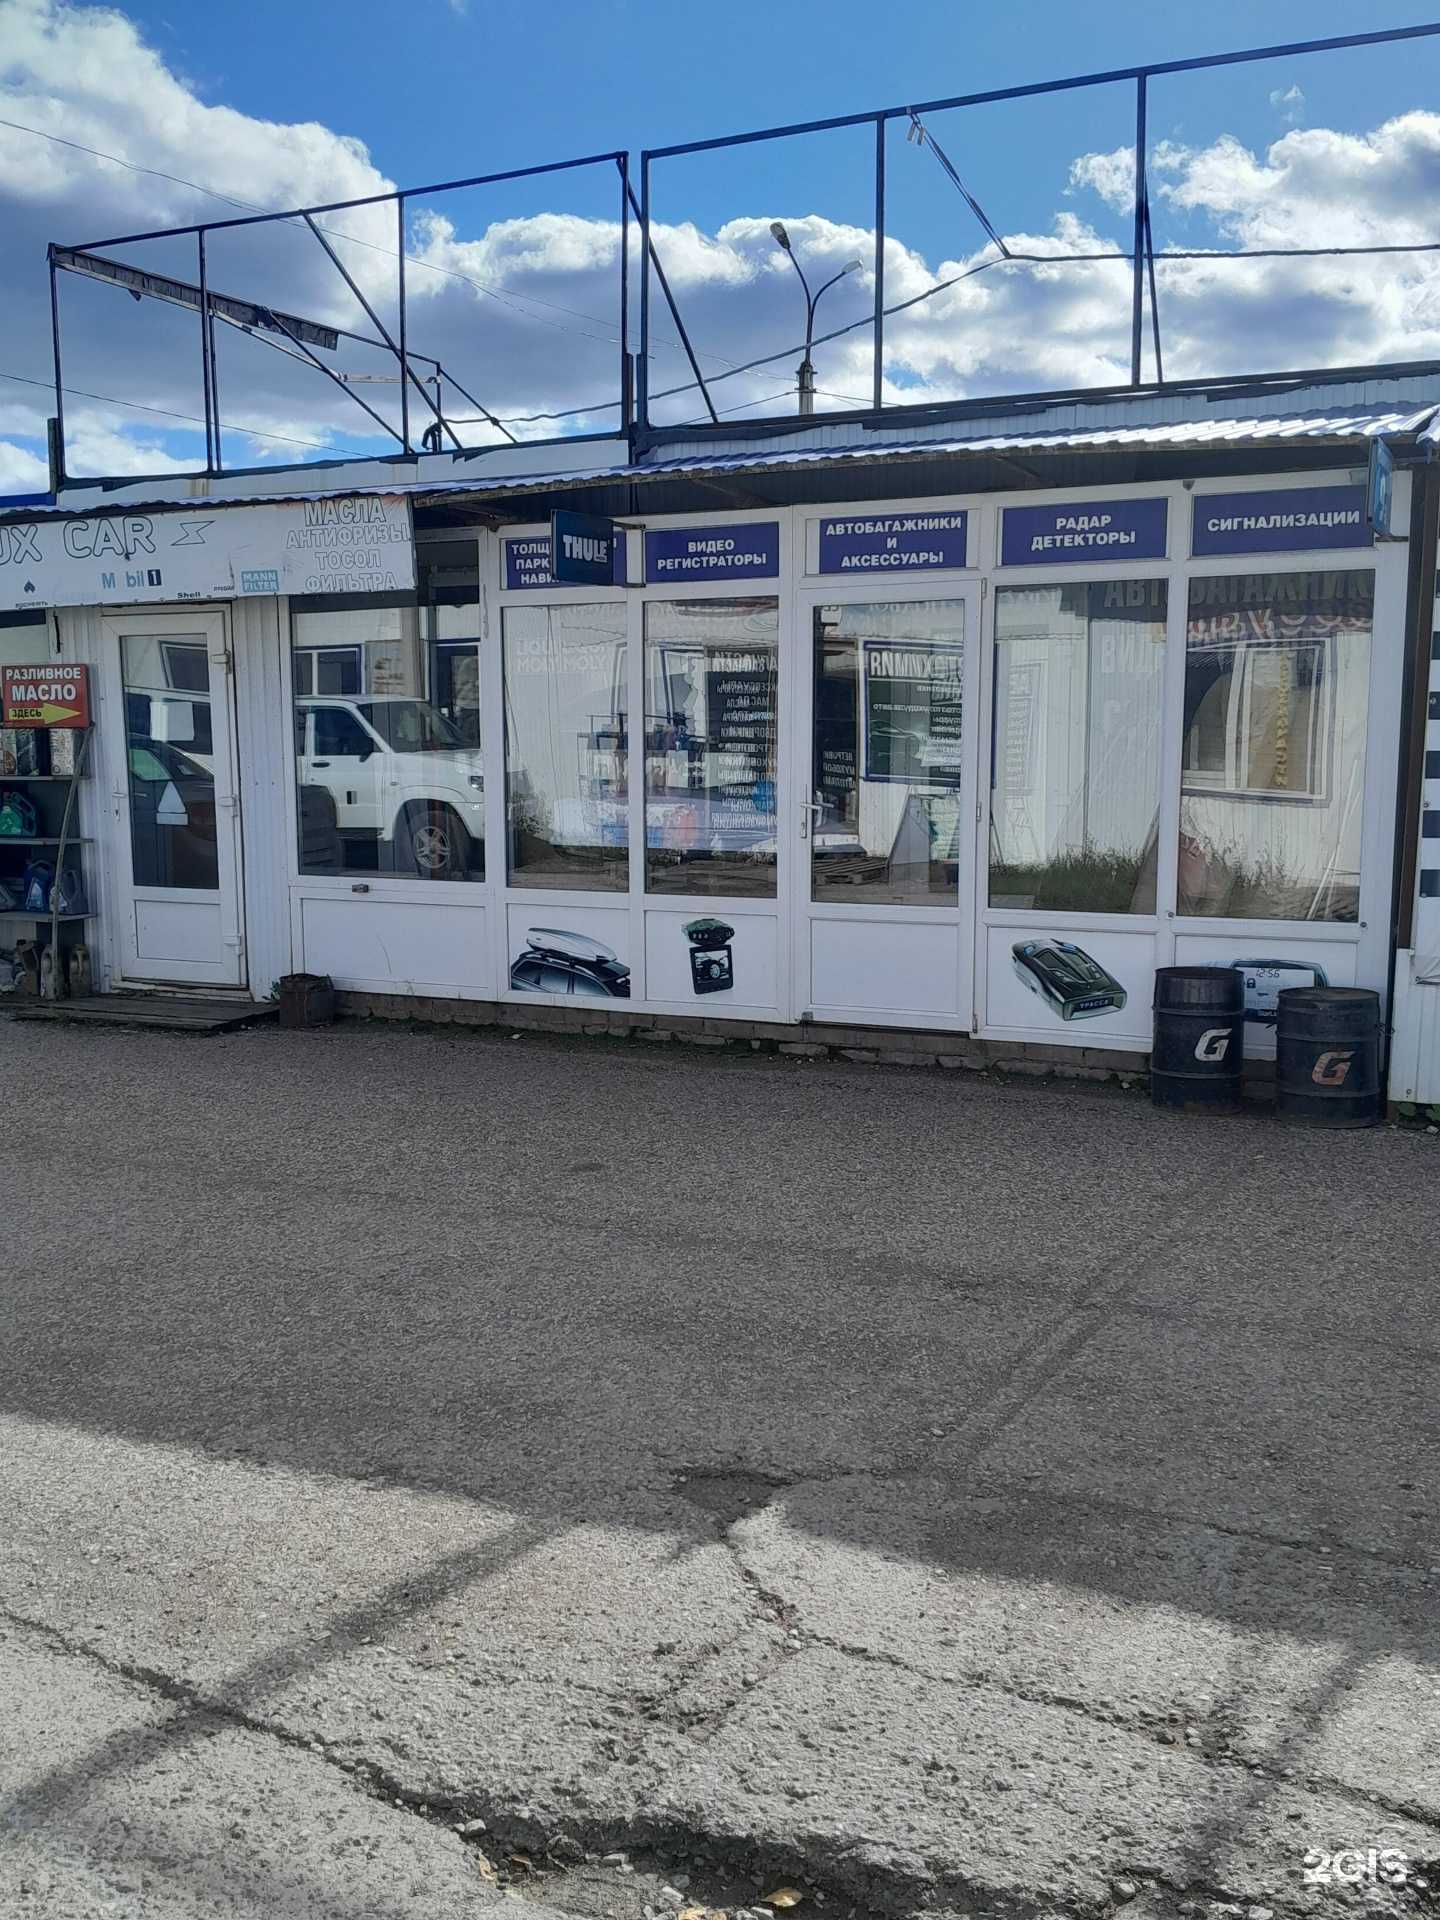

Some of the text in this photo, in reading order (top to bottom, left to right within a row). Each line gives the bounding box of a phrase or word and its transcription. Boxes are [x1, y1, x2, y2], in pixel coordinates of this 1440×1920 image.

[304, 497, 386, 527] МАСЛА
[1207, 510, 1360, 532] СИГНАЛИЗАЦИИ
[825, 516, 962, 536] АВТОБАГАЖНИКИ
[1055, 515, 1112, 531] РАДАР
[63, 515, 157, 559] CAR
[286, 522, 411, 549] АНТИФРИЗЫ
[886, 537, 897, 549] И
[1031, 530, 1136, 551] ДЕТЕКТОРЫ
[511, 541, 551, 555] ТОЛЩ
[562, 534, 609, 563] THULE
[687, 539, 735, 554] ВИДЕО
[314, 548, 382, 570] ТОСОЛ
[515, 557, 550, 570] ПАРК
[657, 552, 767, 570] РЕГИСТРАТОРЫ
[841, 551, 944, 568] АКСЕССУАРЫ
[101, 570, 145, 589] Mbil
[242, 572, 277, 581] MANN
[304, 571, 398, 592] ФИЛЬТРА
[6, 667, 81, 680] РАЗЛИВНОЕ
[12, 684, 76, 701] МАСЛО
[12, 709, 42, 719] ЗДЕСЬ
[1194, 1028, 1233, 1062] G
[1311, 1050, 1356, 1086] G
